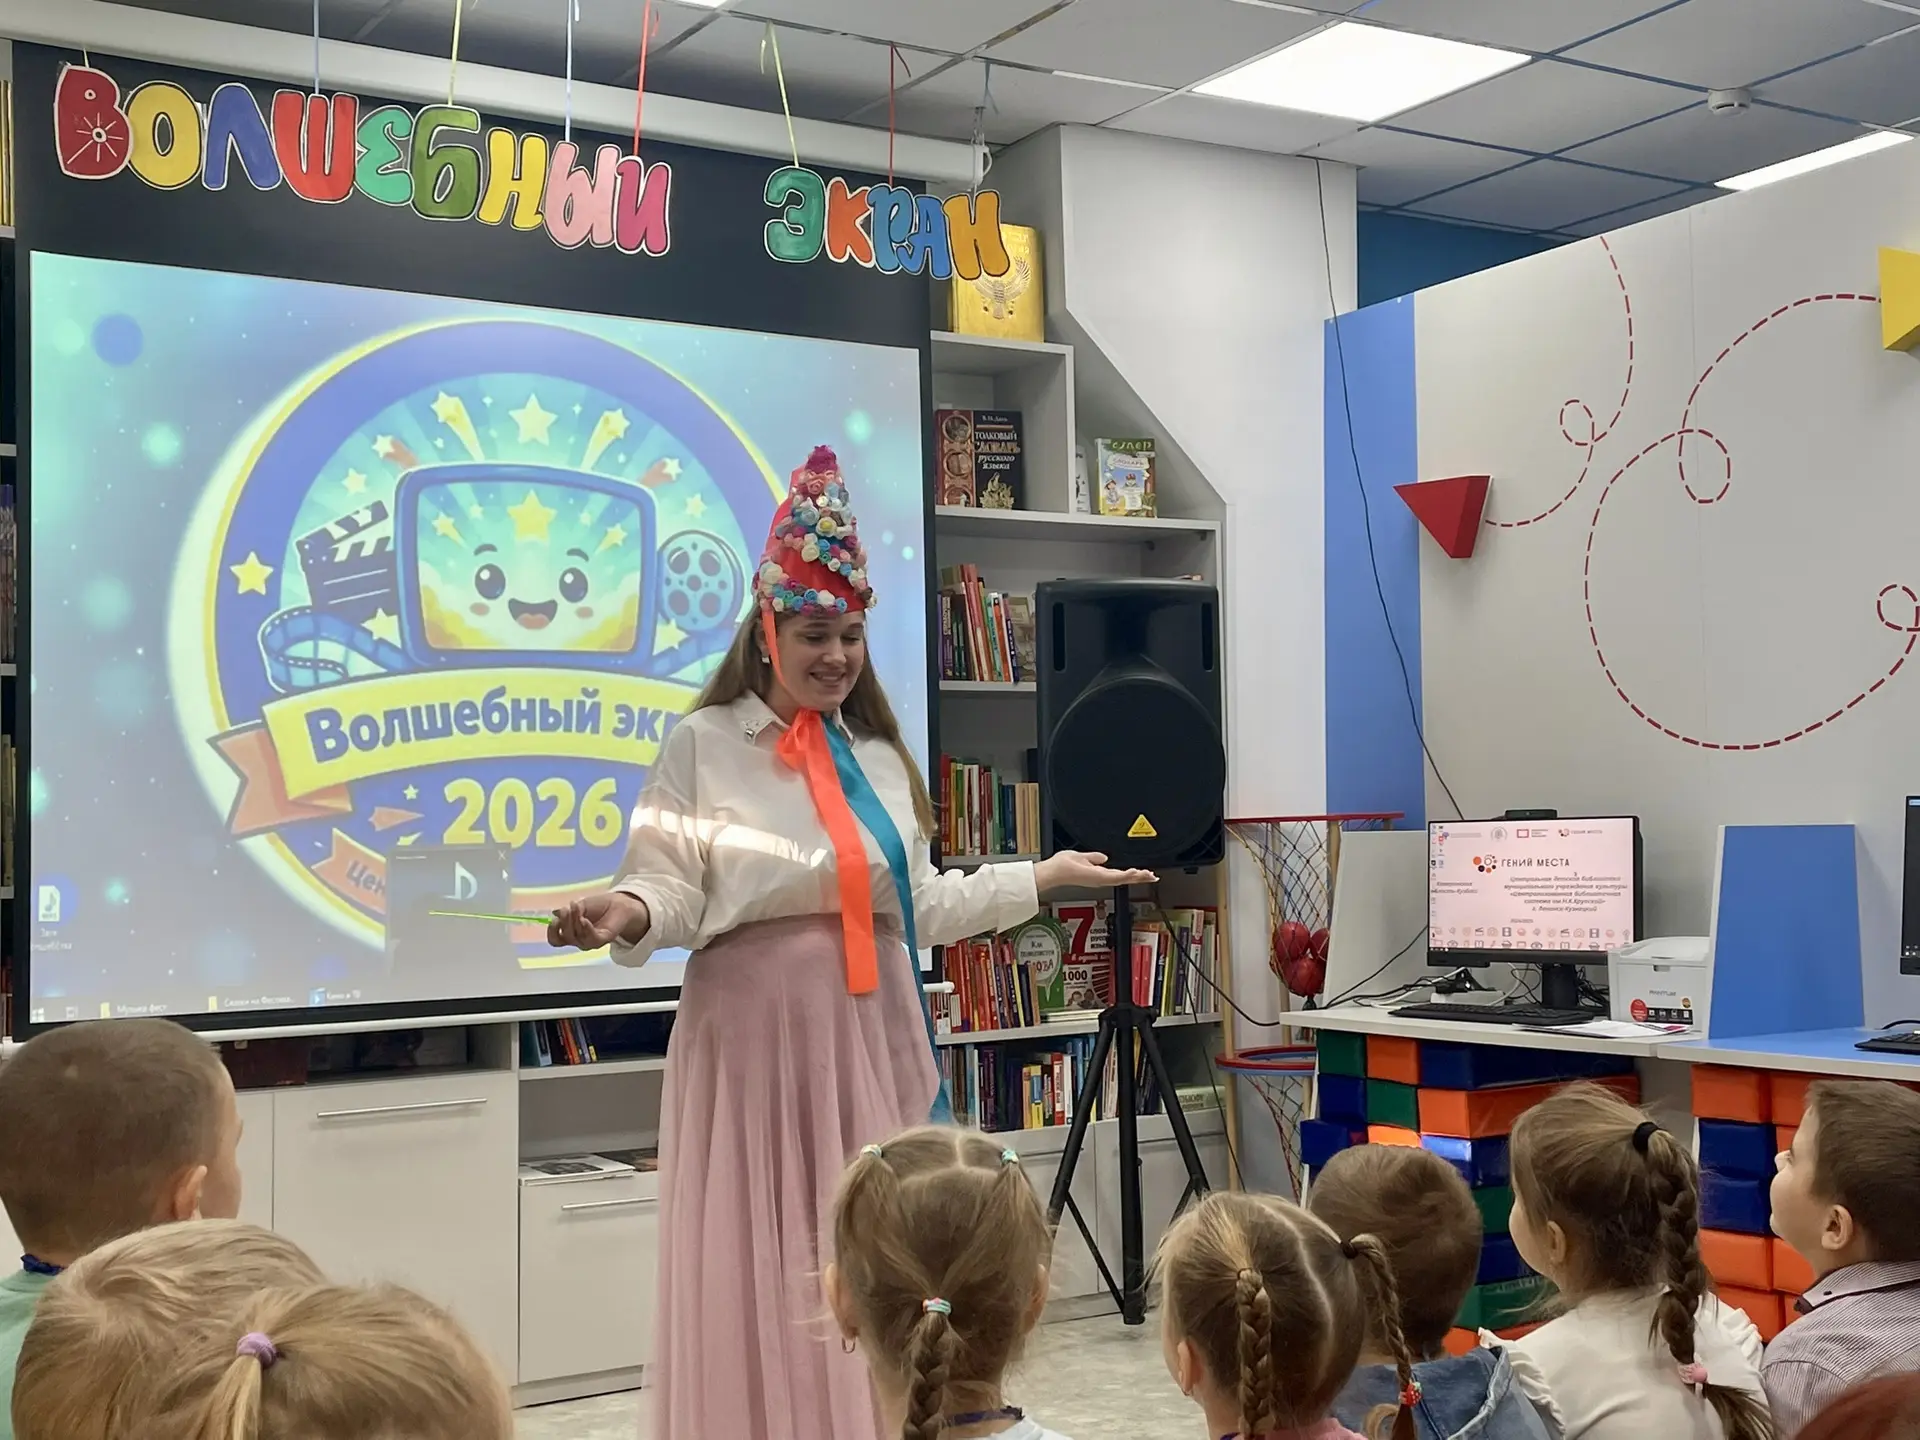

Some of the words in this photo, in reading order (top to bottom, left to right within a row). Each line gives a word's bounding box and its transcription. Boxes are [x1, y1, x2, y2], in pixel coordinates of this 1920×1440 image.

[763, 166, 1010, 281] ЭКРАН
[975, 430, 1017, 440] ТОЛКОВЫЙ
[978, 455, 1015, 463] русского
[305, 686, 602, 763] Волшебный
[443, 777, 623, 849] 2026
[1501, 858, 1533, 867] ГЕНИЙ
[1537, 858, 1570, 867] МЕСТА
[1058, 906, 1096, 955] 7
[1062, 970, 1088, 981] 1000
